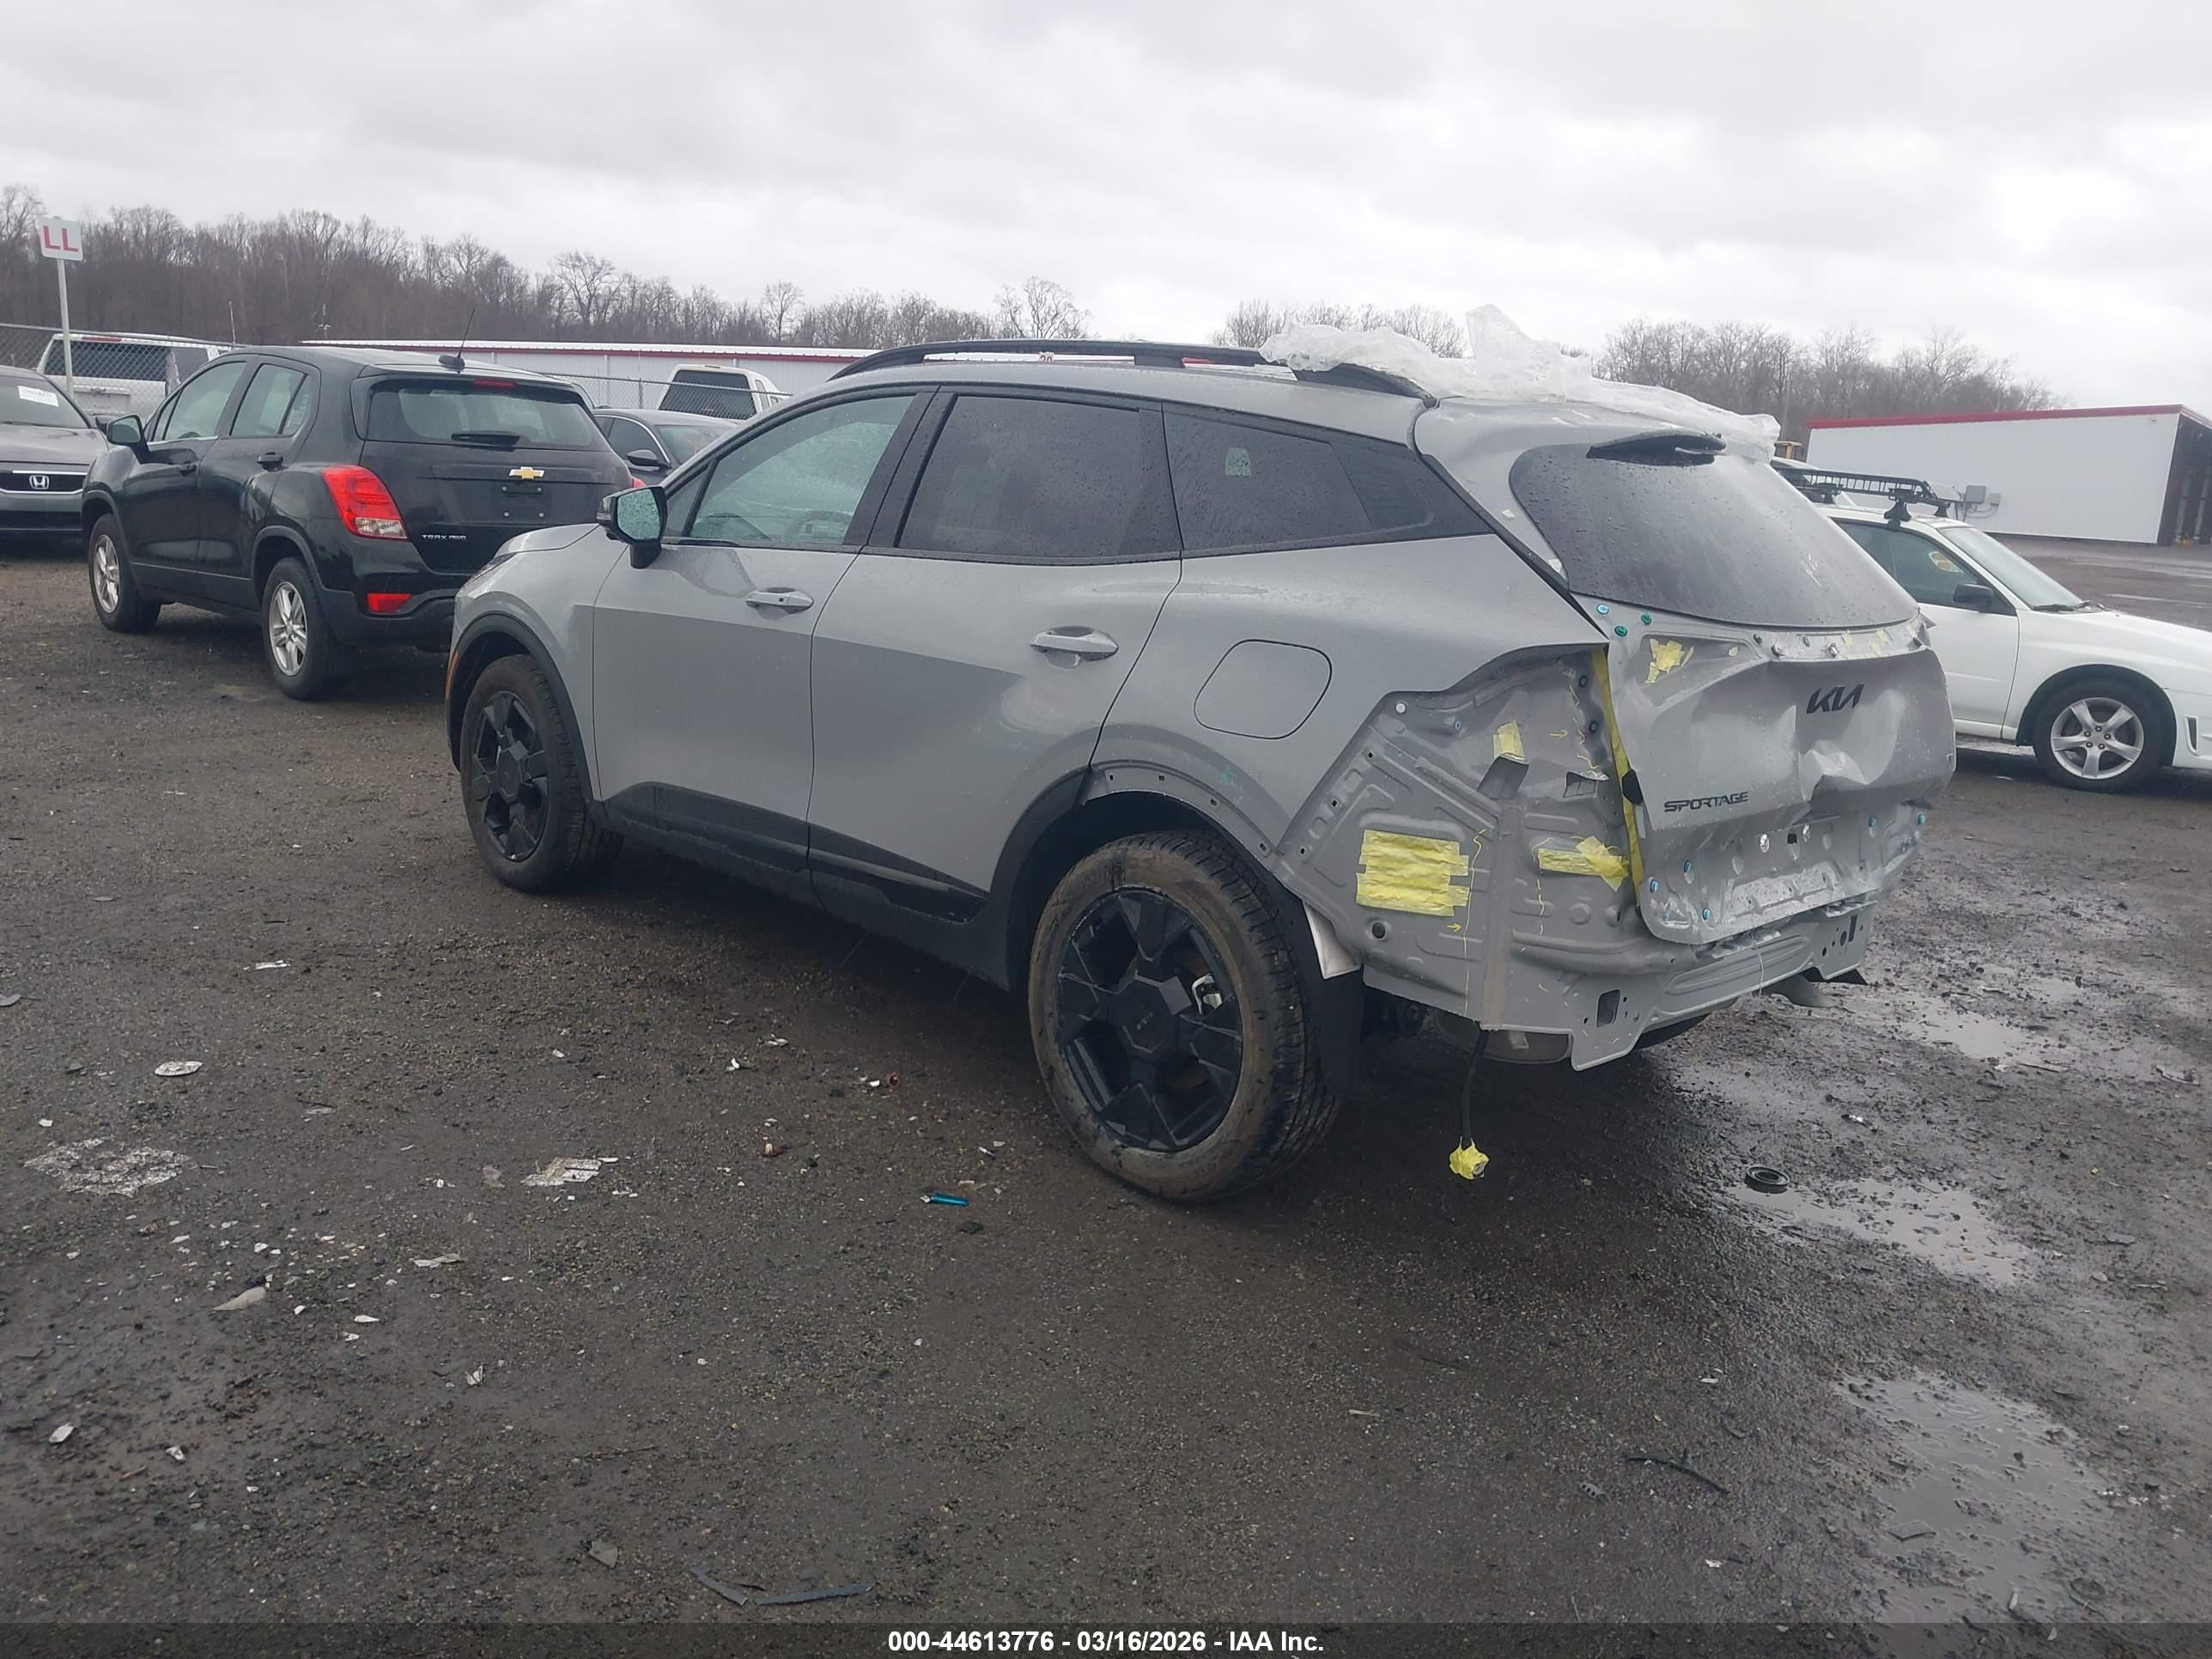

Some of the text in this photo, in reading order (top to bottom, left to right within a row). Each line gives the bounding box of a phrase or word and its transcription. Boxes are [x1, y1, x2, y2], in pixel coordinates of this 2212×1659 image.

[43, 224, 79, 252] LL
[421, 533, 447, 542] TRAX
[1806, 684, 1865, 714] KIA
[1663, 791, 1749, 812] SPORTAGE
